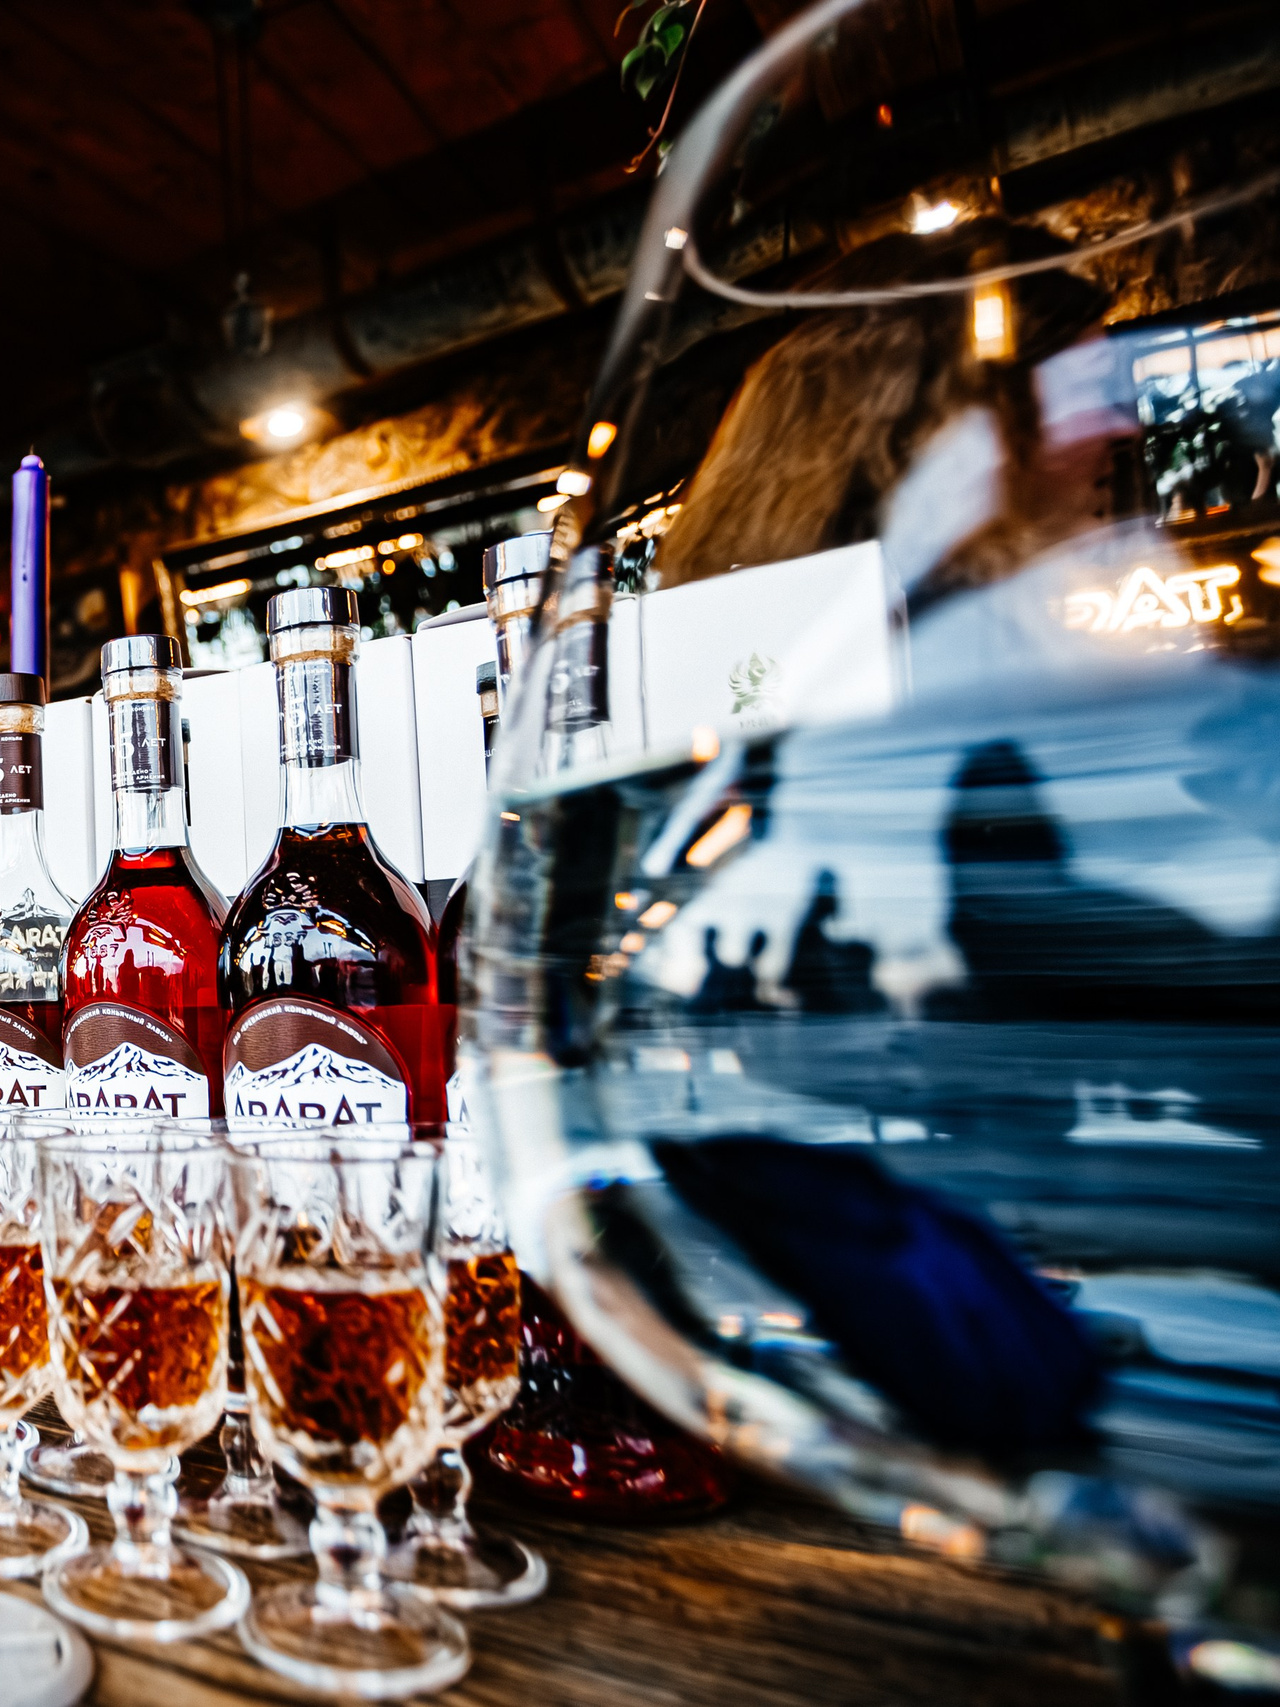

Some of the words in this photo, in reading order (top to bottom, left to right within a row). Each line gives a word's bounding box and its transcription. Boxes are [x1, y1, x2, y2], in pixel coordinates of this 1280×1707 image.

[314, 703, 343, 714] ЛЕТ
[141, 737, 167, 748] ЛЕТ
[9, 764, 33, 775] ЛЕТ
